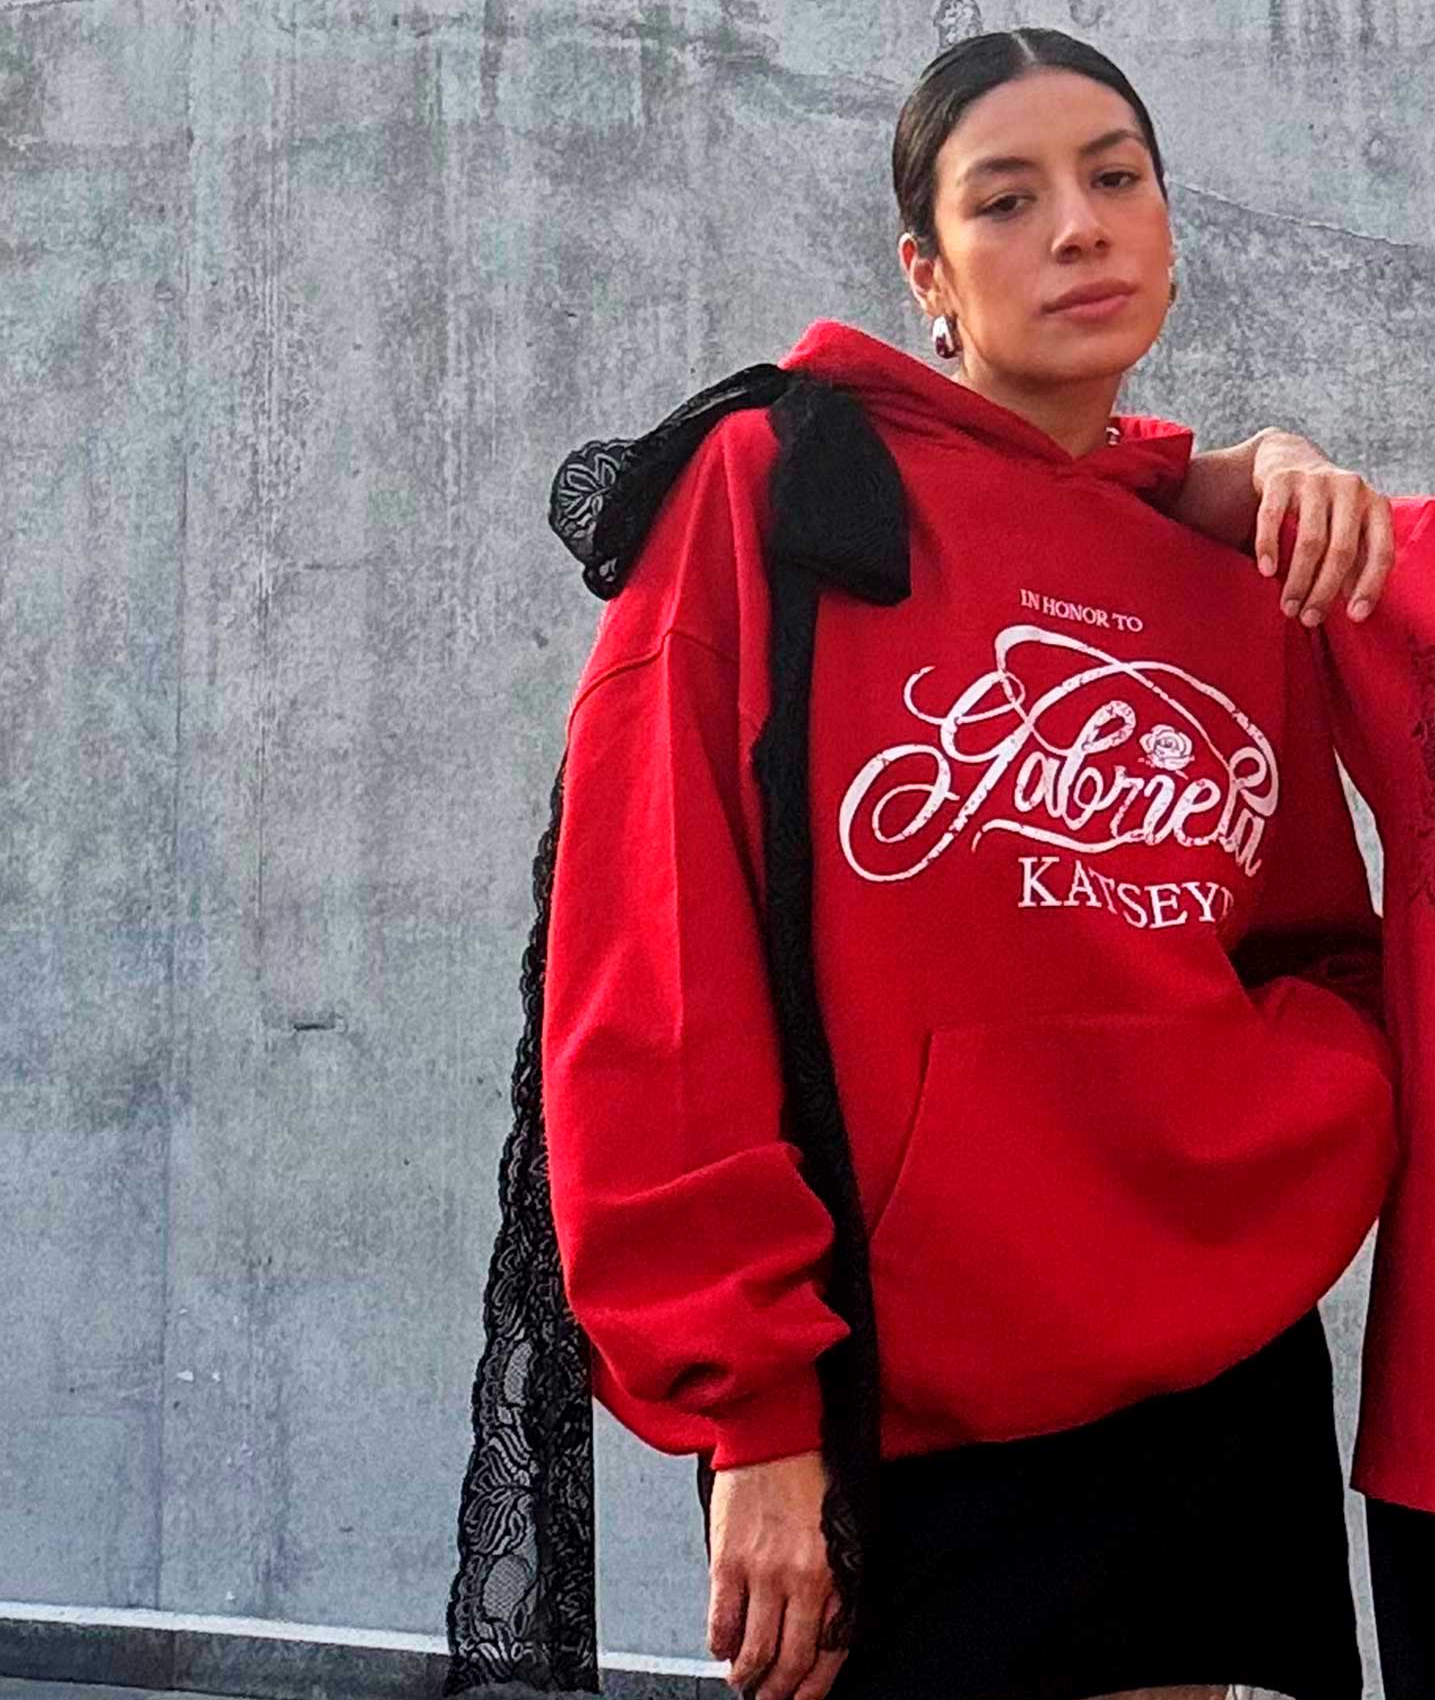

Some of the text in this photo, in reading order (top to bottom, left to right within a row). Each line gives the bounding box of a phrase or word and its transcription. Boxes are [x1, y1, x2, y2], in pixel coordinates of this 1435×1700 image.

[1020, 588, 1144, 633] IN HONOR TO
